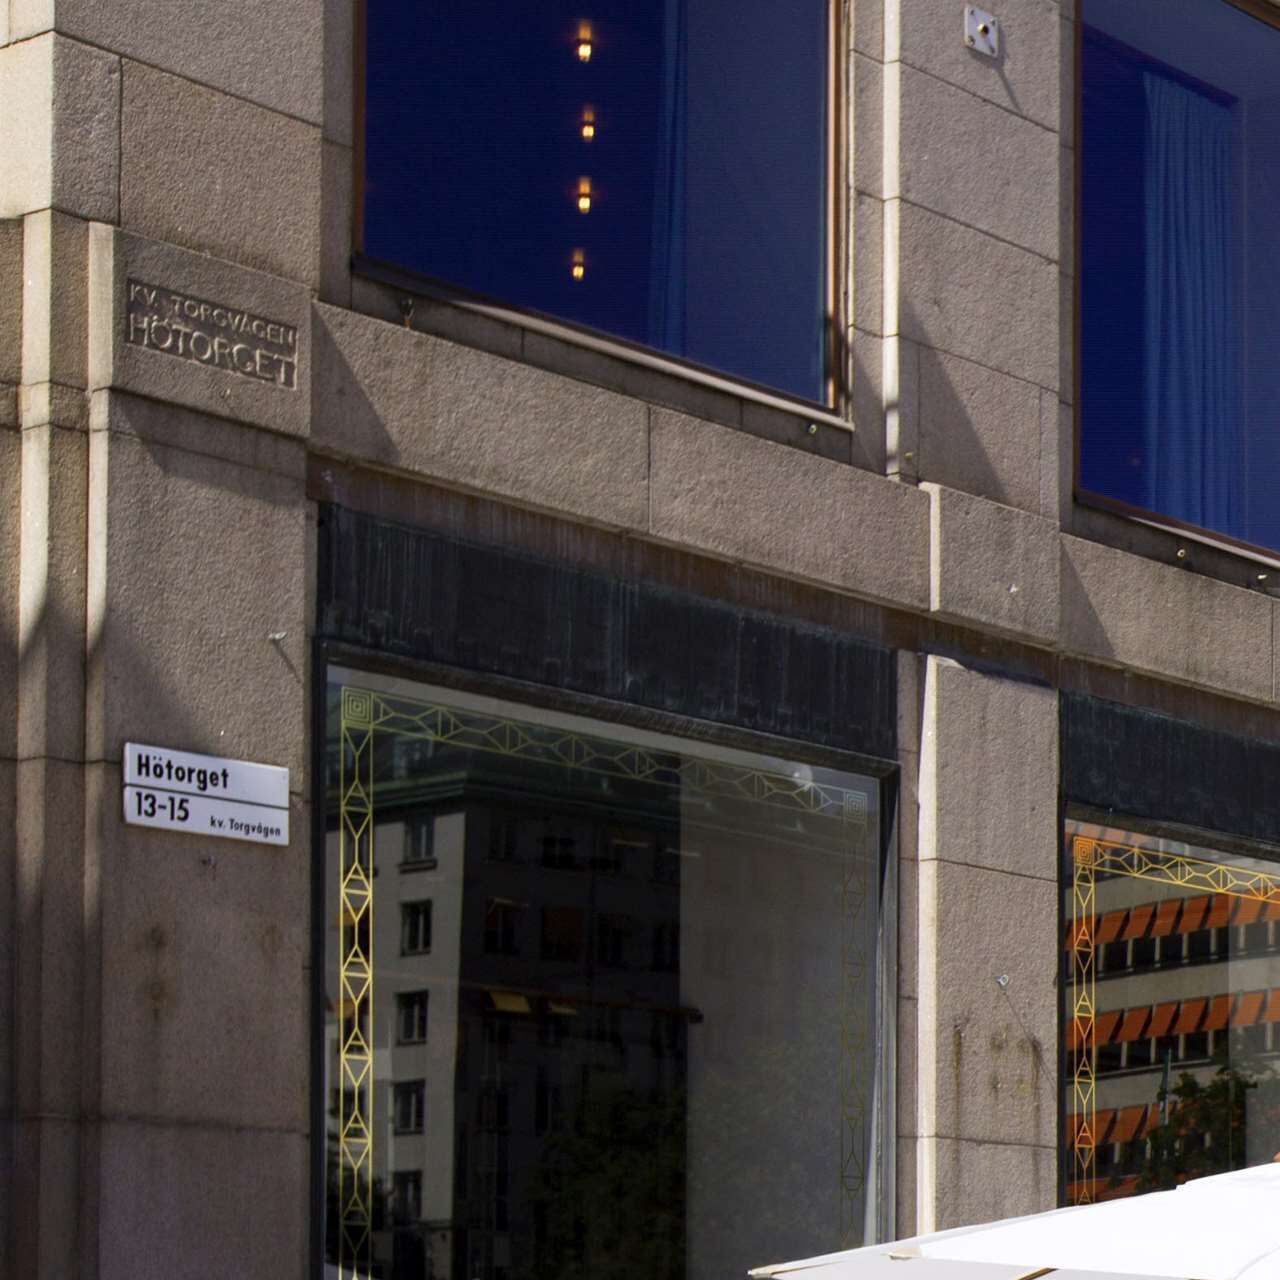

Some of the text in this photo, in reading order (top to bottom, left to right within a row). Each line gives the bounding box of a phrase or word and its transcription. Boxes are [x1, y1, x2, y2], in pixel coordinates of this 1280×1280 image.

[130, 313, 295, 384] HÖTORGET
[137, 753, 229, 791] Hötorget
[135, 791, 190, 822] 13-15
